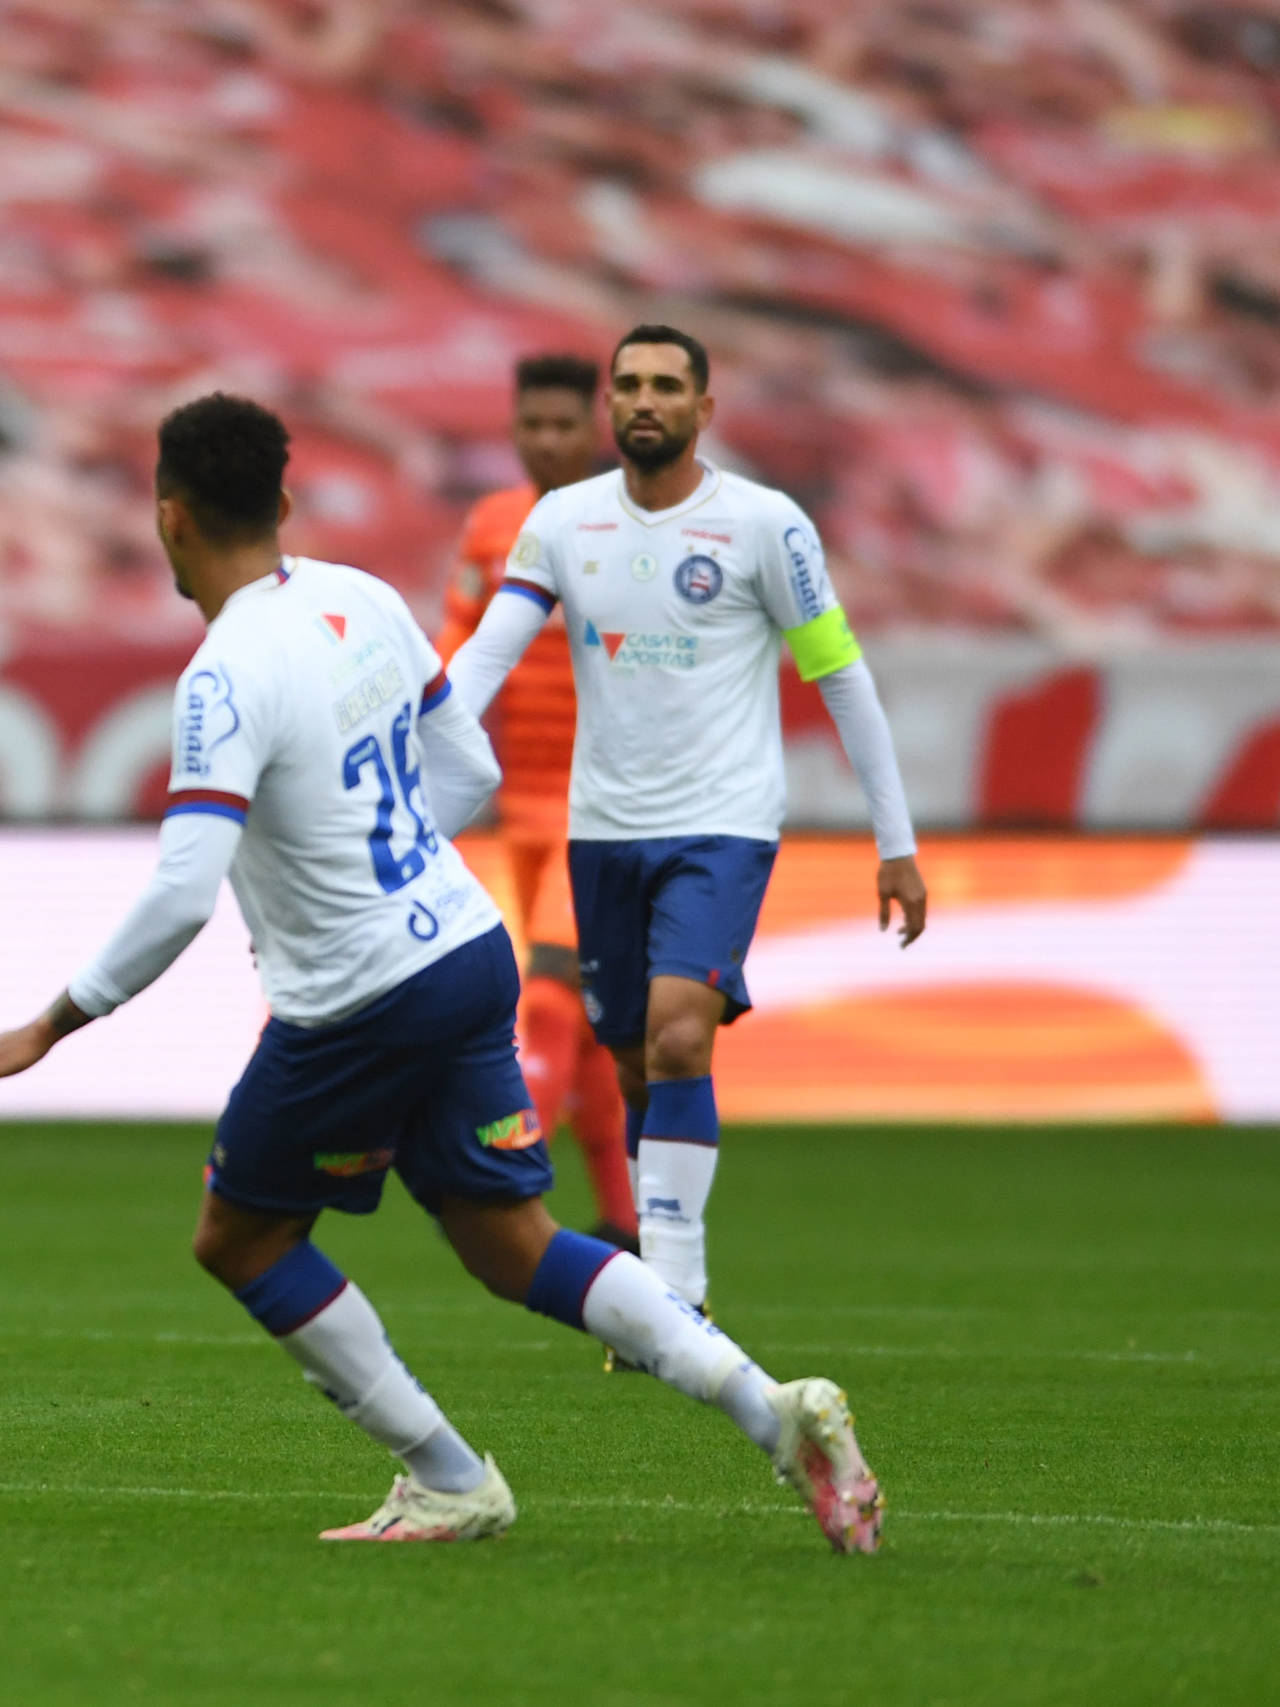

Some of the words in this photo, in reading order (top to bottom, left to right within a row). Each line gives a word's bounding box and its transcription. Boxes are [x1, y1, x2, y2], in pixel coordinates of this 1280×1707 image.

[625, 631, 673, 650] CASA
[183, 668, 221, 778] Canaã
[341, 701, 440, 895] 26
